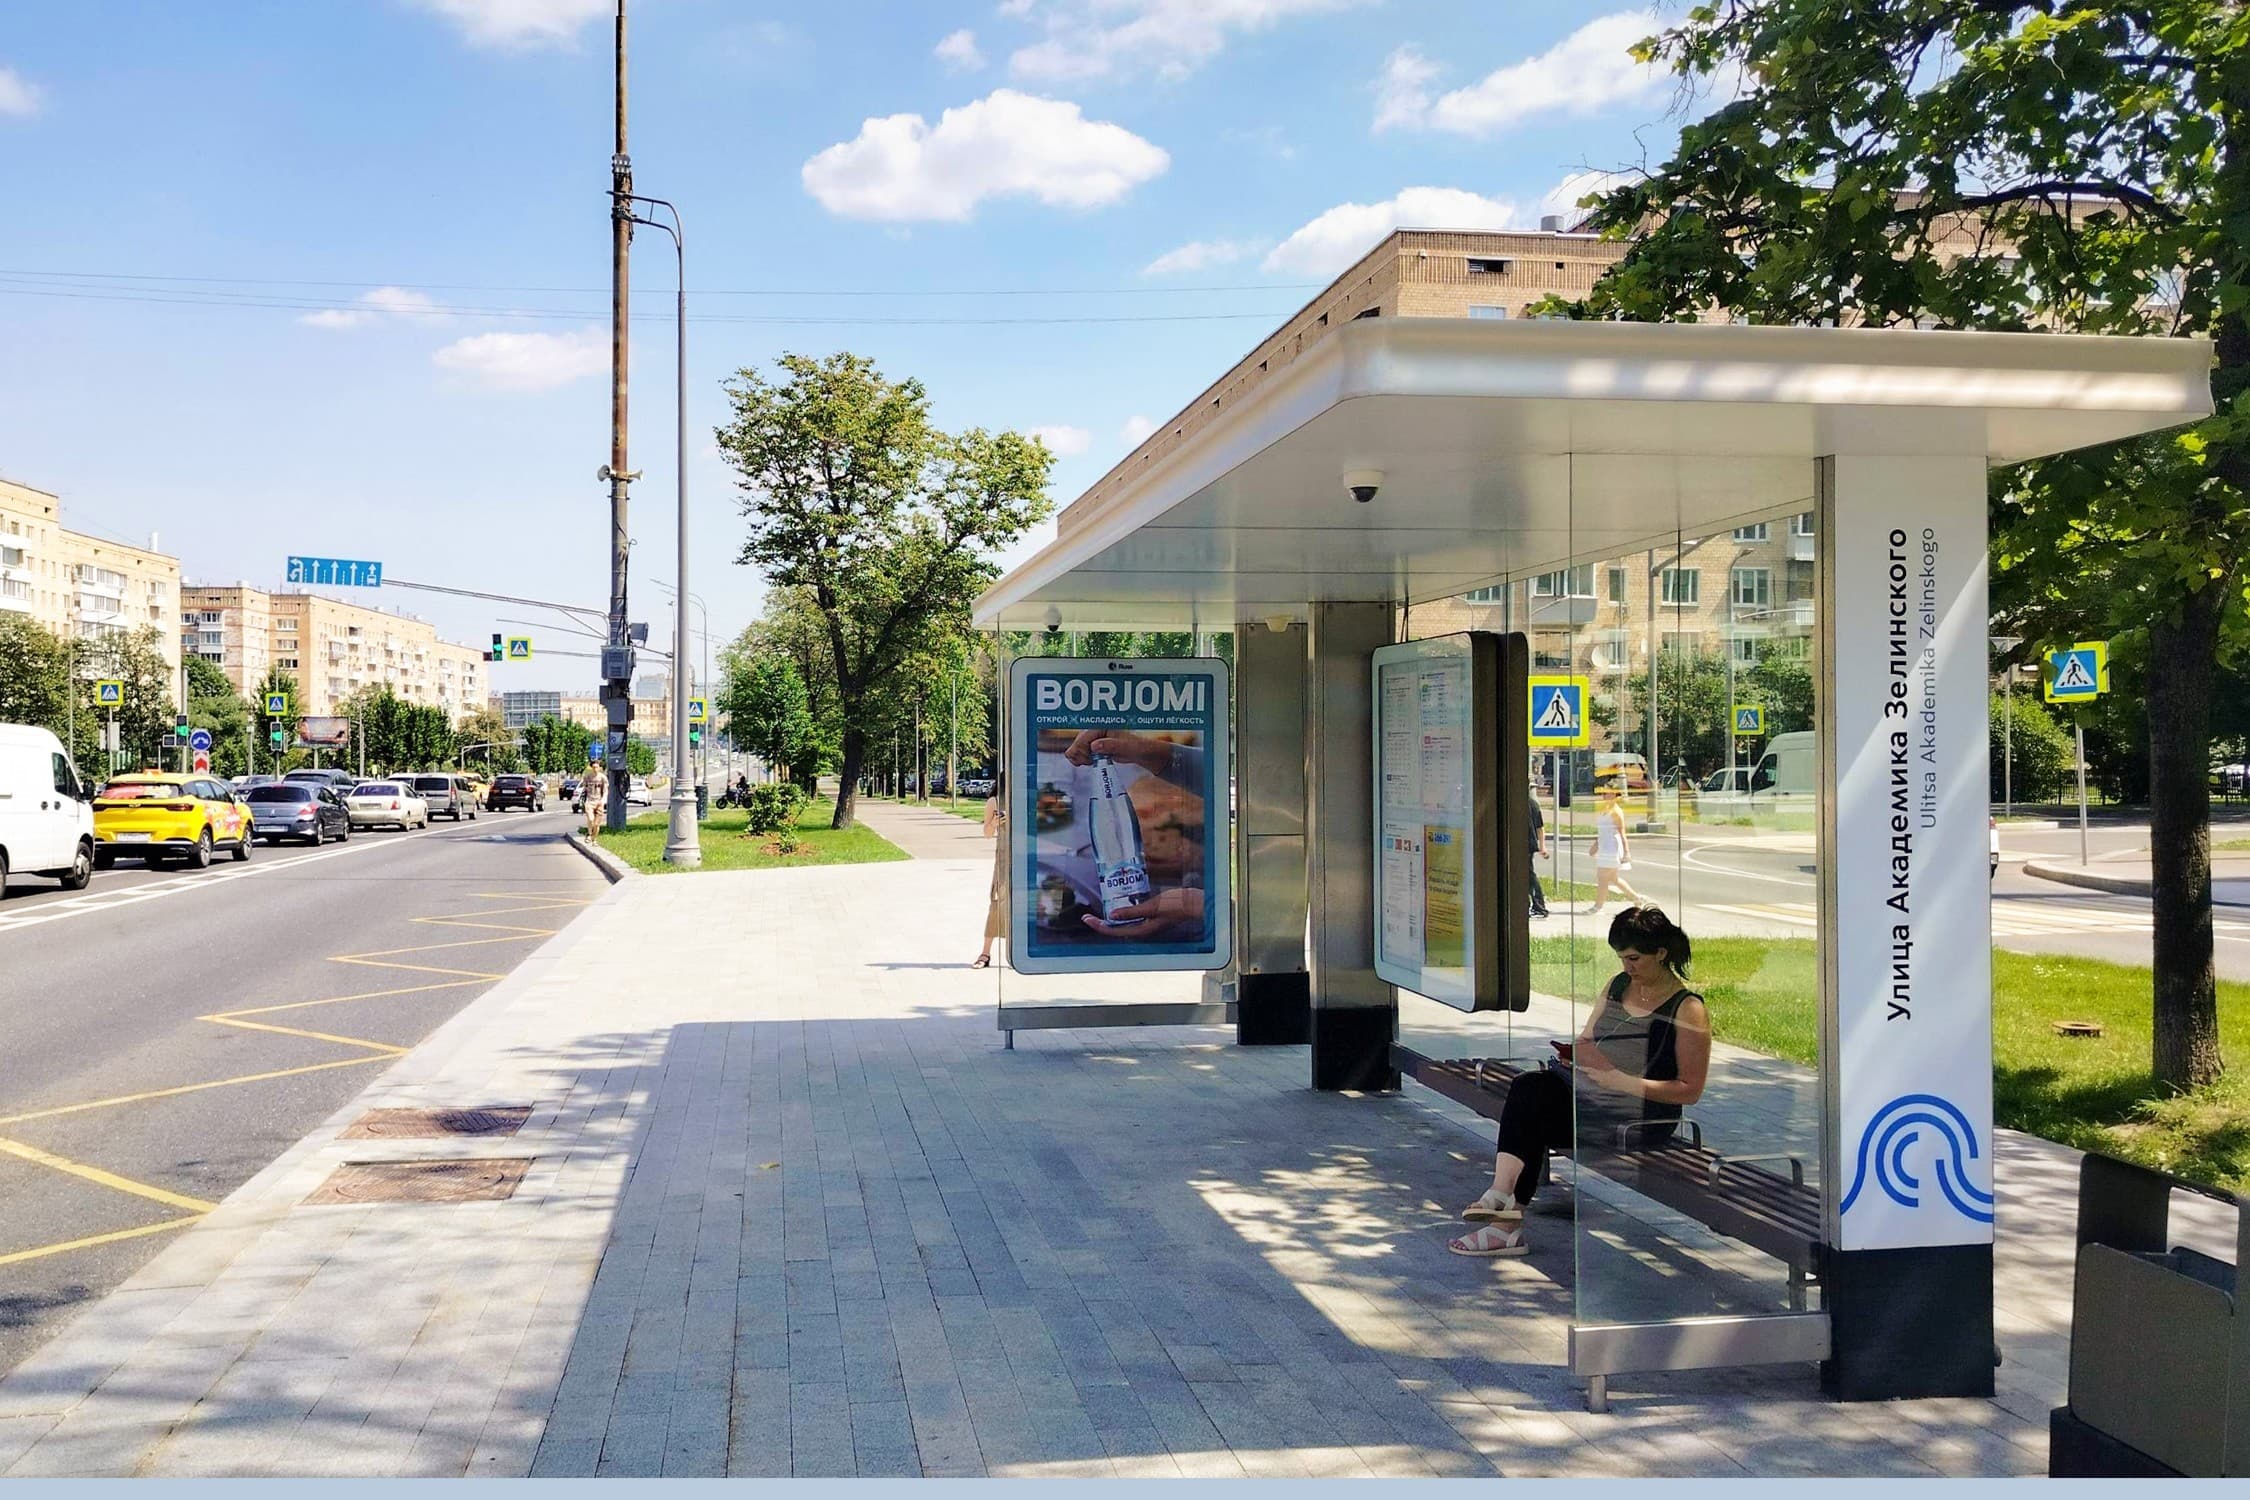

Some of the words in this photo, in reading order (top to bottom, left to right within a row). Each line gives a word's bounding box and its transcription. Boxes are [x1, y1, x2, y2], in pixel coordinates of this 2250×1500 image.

[1884, 528, 1908, 720] Зелинского
[1918, 527, 1939, 639] Zelinskogo
[1036, 679, 1205, 712] BORJOMI
[1036, 715, 1068, 724] ОТКРОЙ
[1080, 716, 1126, 725] НАСЛАДИСЬ
[1137, 716, 1165, 726] ОЩУТИ
[1919, 645, 1936, 764] Akademika
[1886, 731, 1912, 914] Академика
[1919, 770, 1936, 830] Ulitsa
[1107, 873, 1144, 888] BORJOMI
[1887, 925, 1913, 1022] Улица
